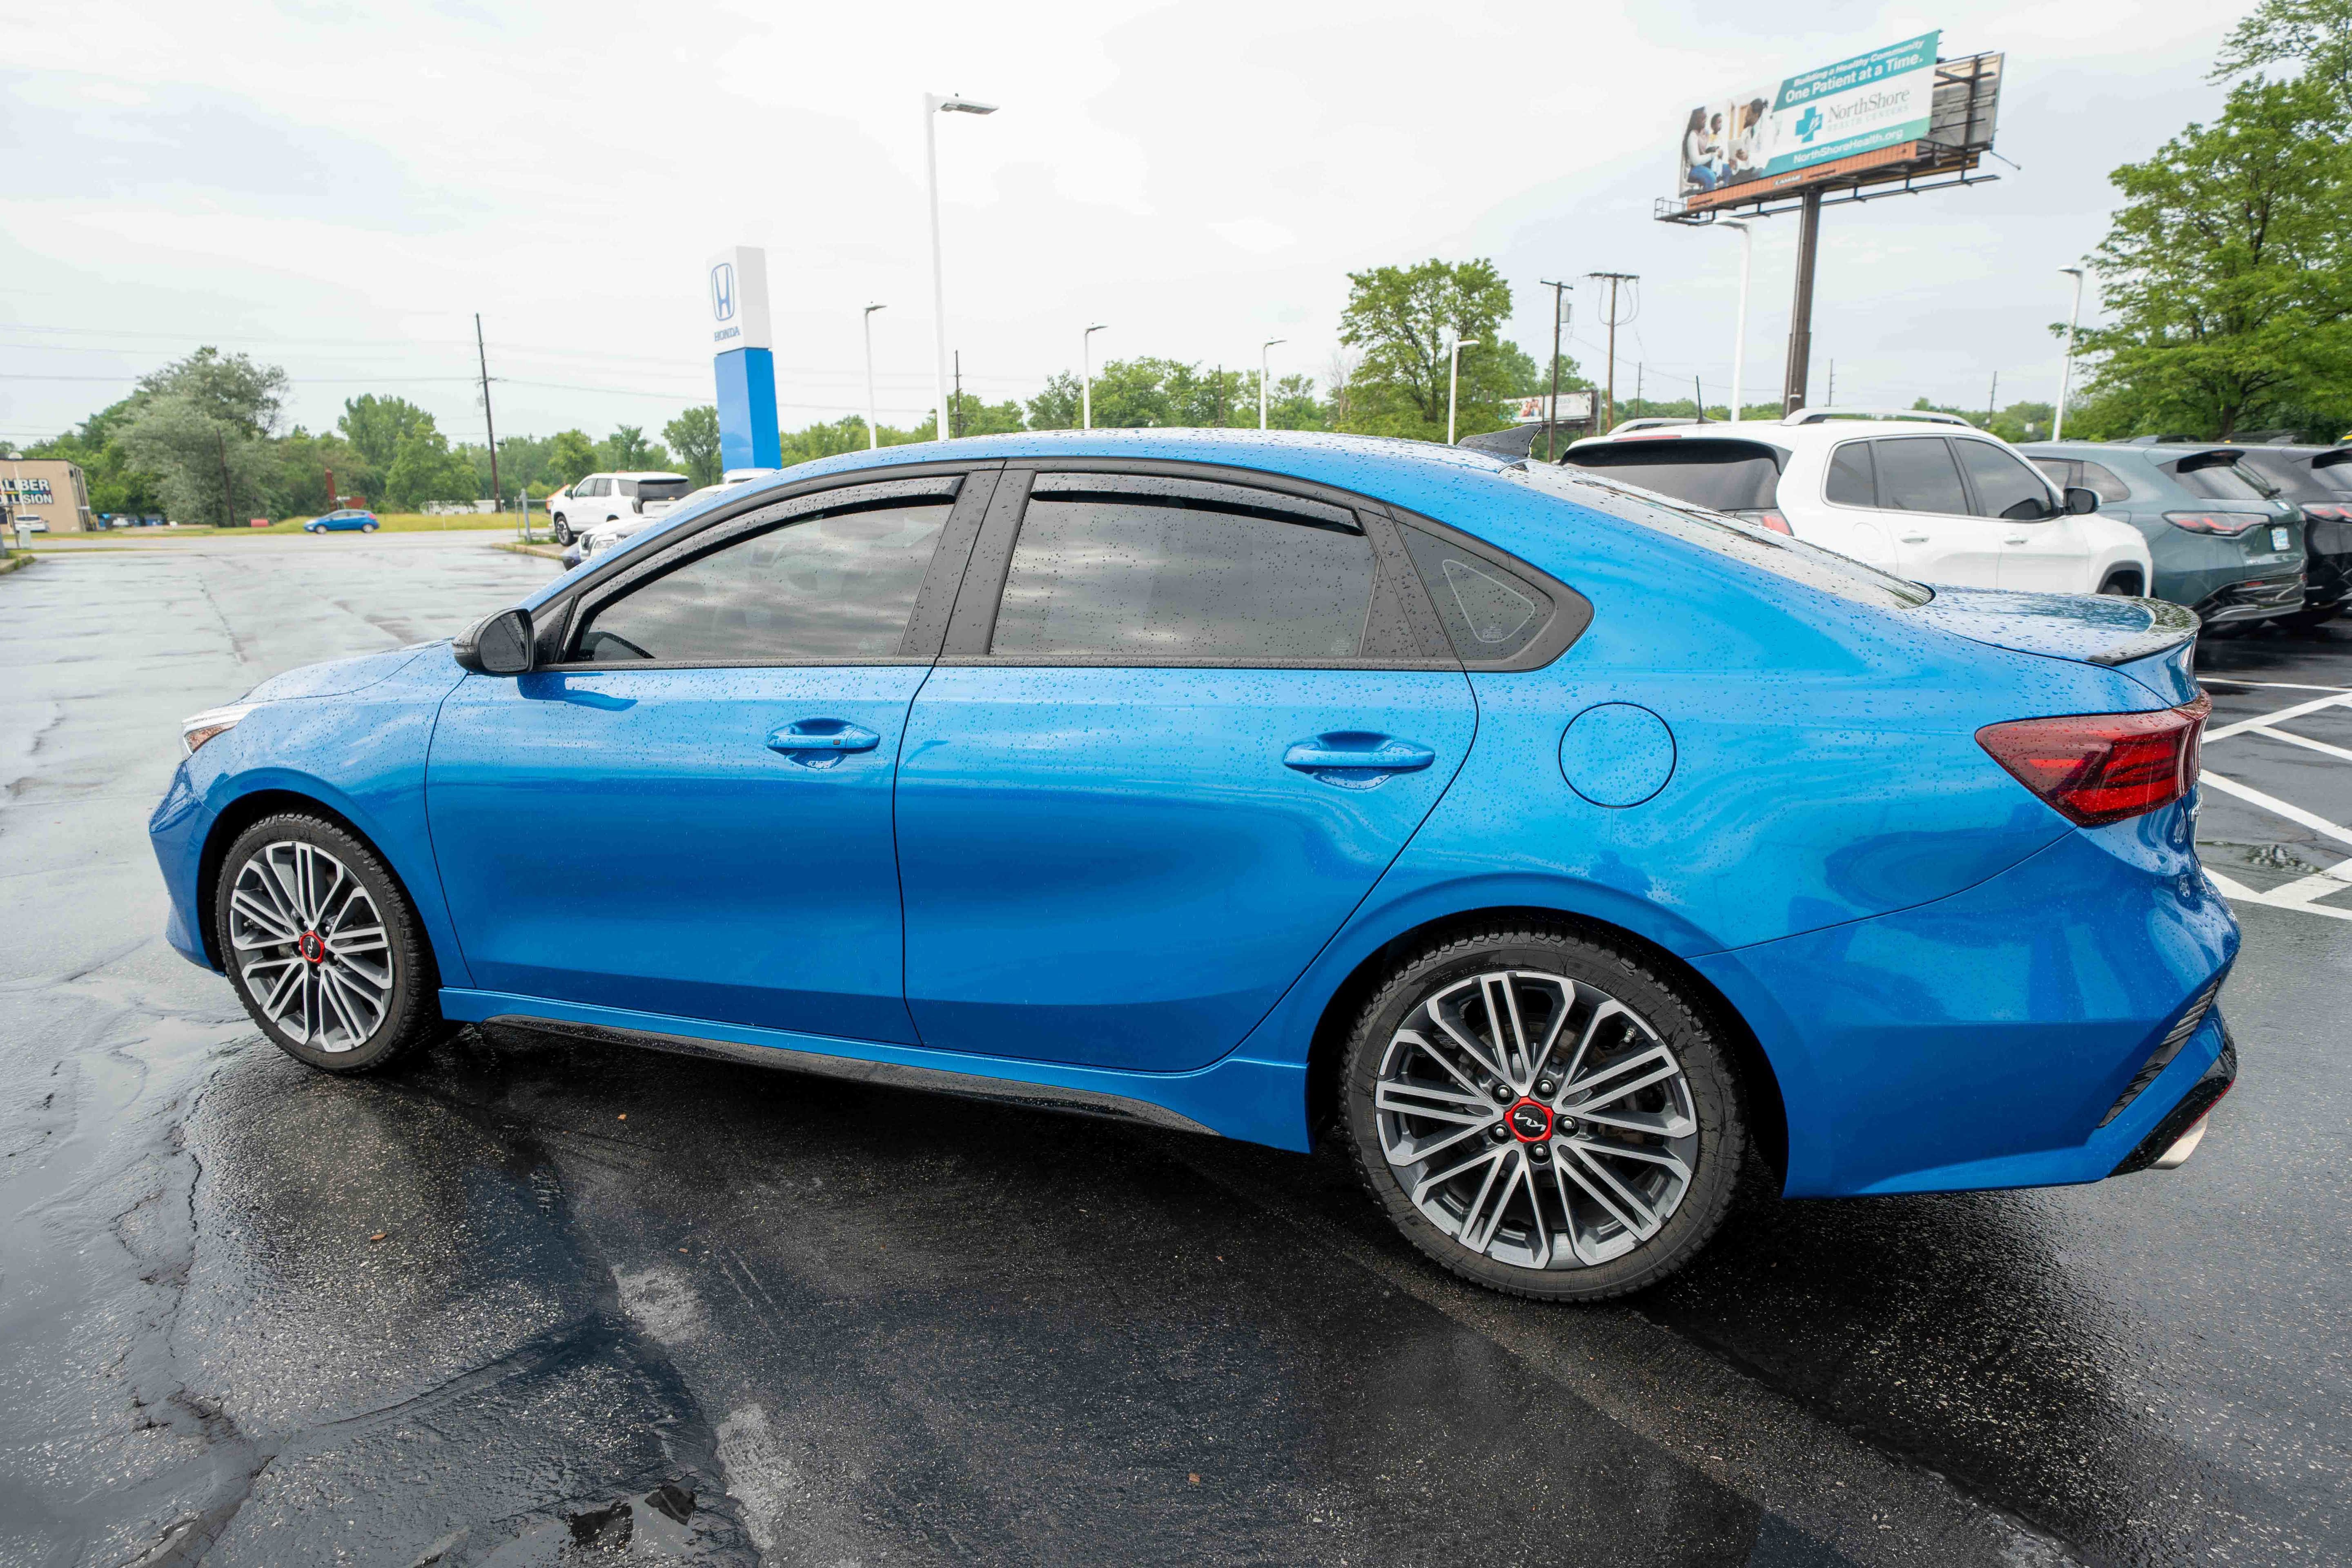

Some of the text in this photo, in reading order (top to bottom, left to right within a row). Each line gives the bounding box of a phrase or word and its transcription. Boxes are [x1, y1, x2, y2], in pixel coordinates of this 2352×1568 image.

[1871, 40, 1925, 62] Community
[1785, 53, 1924, 103] One Patient at a Time.
[1828, 89, 1910, 123] NorthShore
[1793, 129, 1904, 164] NorthShoreHealth.org
[715, 326, 740, 341] HONDA
